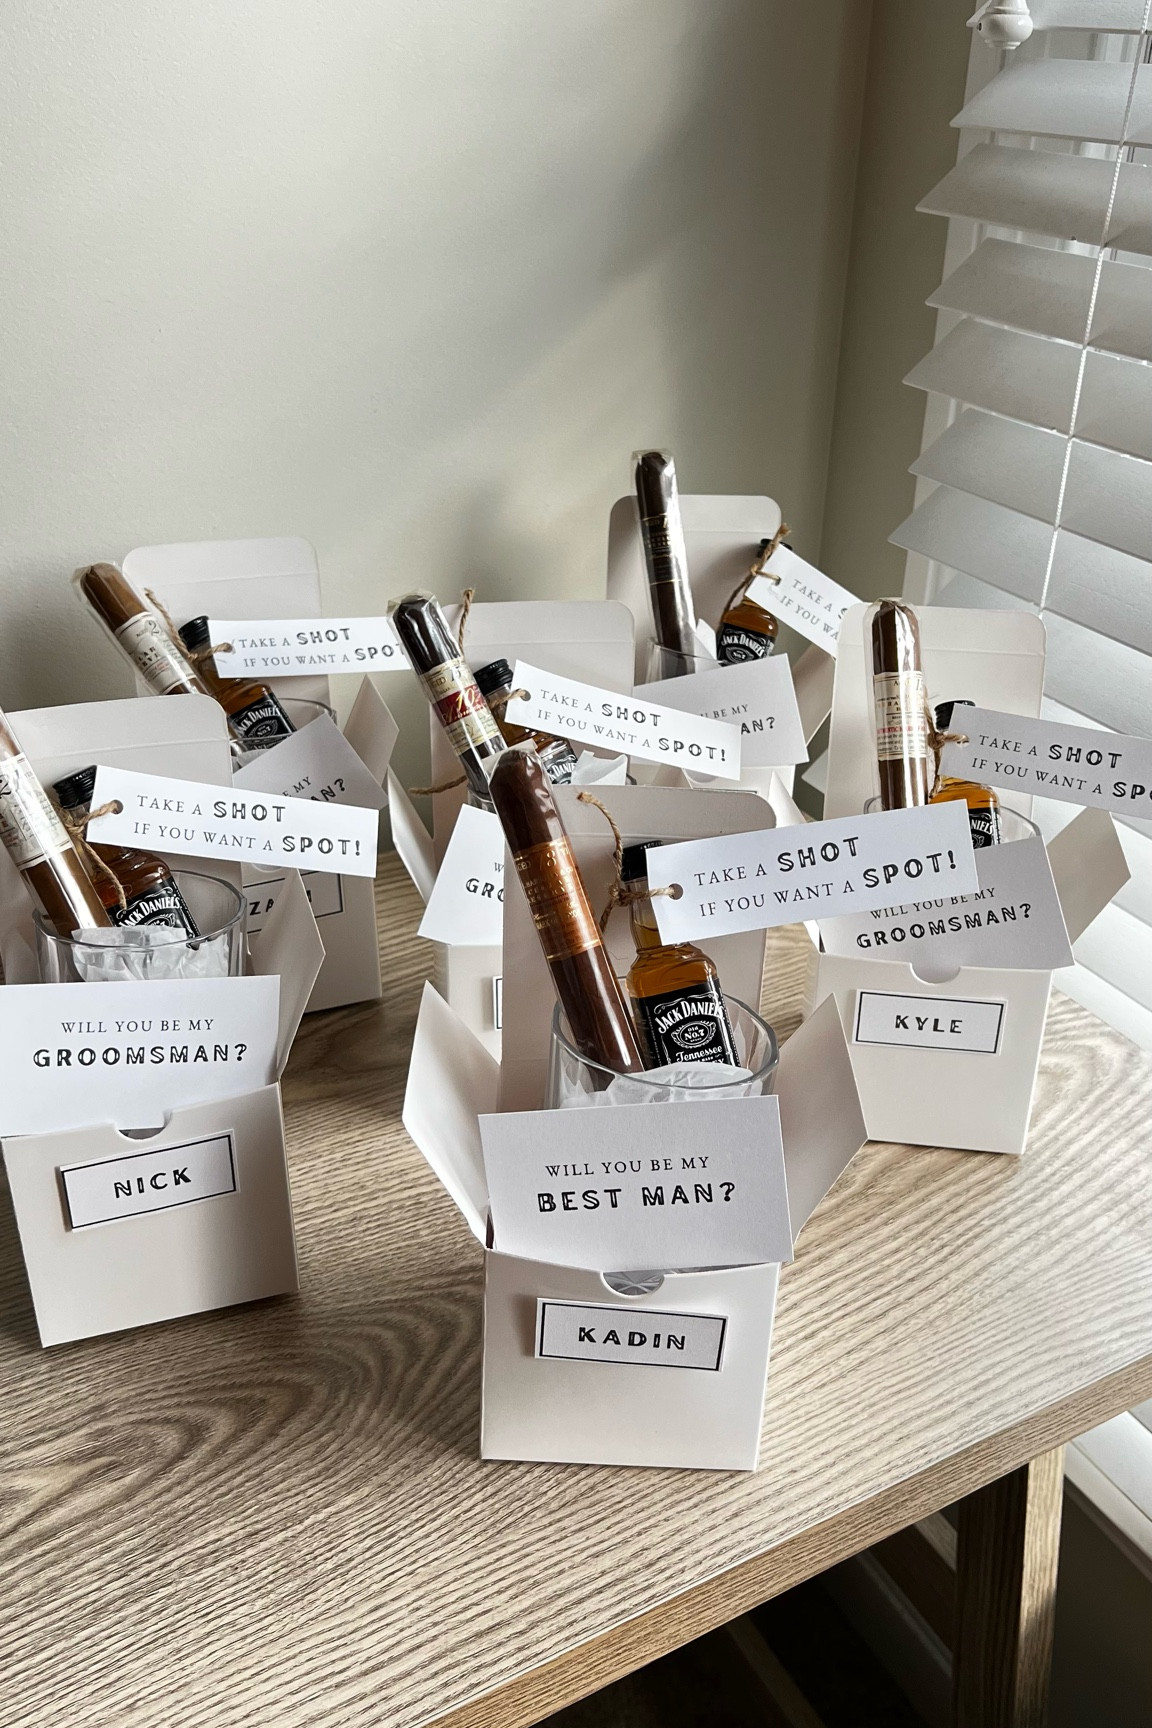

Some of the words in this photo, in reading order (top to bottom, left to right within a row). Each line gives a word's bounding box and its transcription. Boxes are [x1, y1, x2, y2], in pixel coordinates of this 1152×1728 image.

[792, 579, 823, 605] TAKE
[824, 603, 832, 612] A
[780, 595, 793, 607] IF
[795, 605, 820, 625] YOU
[822, 622, 839, 640] WA
[239, 638, 277, 649] TAKE
[282, 637, 291, 647] A
[296, 627, 350, 645] SHOT
[244, 657, 256, 667] IF
[262, 656, 290, 667] YOU
[295, 653, 337, 665] WANT
[342, 653, 350, 663] A
[540, 689, 579, 709] TAKE
[584, 702, 593, 713] A
[601, 702, 661, 727] SHOT
[713, 708, 728, 719] BE
[731, 703, 749, 715] MY
[537, 709, 551, 720] IF
[558, 714, 588, 731] YOU
[593, 724, 637, 745] WANT
[642, 737, 651, 749] A
[658, 737, 726, 762] SPOT!
[740, 716, 776, 735] AN?
[979, 734, 1022, 753] TAKE
[1027, 745, 1038, 756] A
[1048, 744, 1122, 769] SHOT
[293, 776, 311, 793] MY
[972, 757, 988, 769] IF
[994, 762, 1029, 778] YOU
[1035, 770, 1088, 791] WANT
[1092, 783, 1103, 795] A
[1112, 781, 1152, 800] SP
[137, 794, 185, 814] TAKE
[192, 803, 202, 816] A
[213, 801, 286, 822] SHOT
[134, 822, 151, 835] IF
[158, 825, 195, 841] YOU
[203, 831, 256, 849] WANT
[263, 840, 273, 851] A
[282, 835, 361, 857] SPOT!
[970, 818, 994, 835] NIEL'S
[694, 866, 747, 887] TAKE
[755, 863, 767, 876] A
[777, 836, 860, 872] SHOT
[700, 902, 717, 917] IF
[724, 893, 765, 913] YOU
[773, 882, 834, 905] WANT
[843, 880, 855, 894] A
[862, 850, 957, 889] SPOT!
[870, 905, 908, 920] WILL
[913, 898, 944, 912] YOU
[974, 887, 995, 901] MY
[856, 903, 1032, 949] GROOMSMAN?
[60, 1021, 107, 1034] WILL
[115, 1020, 153, 1033] YOU
[160, 1020, 181, 1032] BE
[188, 1019, 214, 1031] MY
[654, 1006, 684, 1034] JACK
[895, 1015, 963, 1034] KYLE
[33, 1043, 247, 1067] GROOMSMAN?
[675, 1045, 723, 1063] Tennessee
[545, 1163, 595, 1177] WILL
[601, 1160, 642, 1174] YOU
[650, 1158, 673, 1172] BE
[681, 1156, 710, 1170] MY
[114, 1167, 191, 1199] NICK
[538, 1188, 622, 1213] BEST
[641, 1181, 736, 1207] MAN?
[578, 1327, 686, 1351] KADIN
